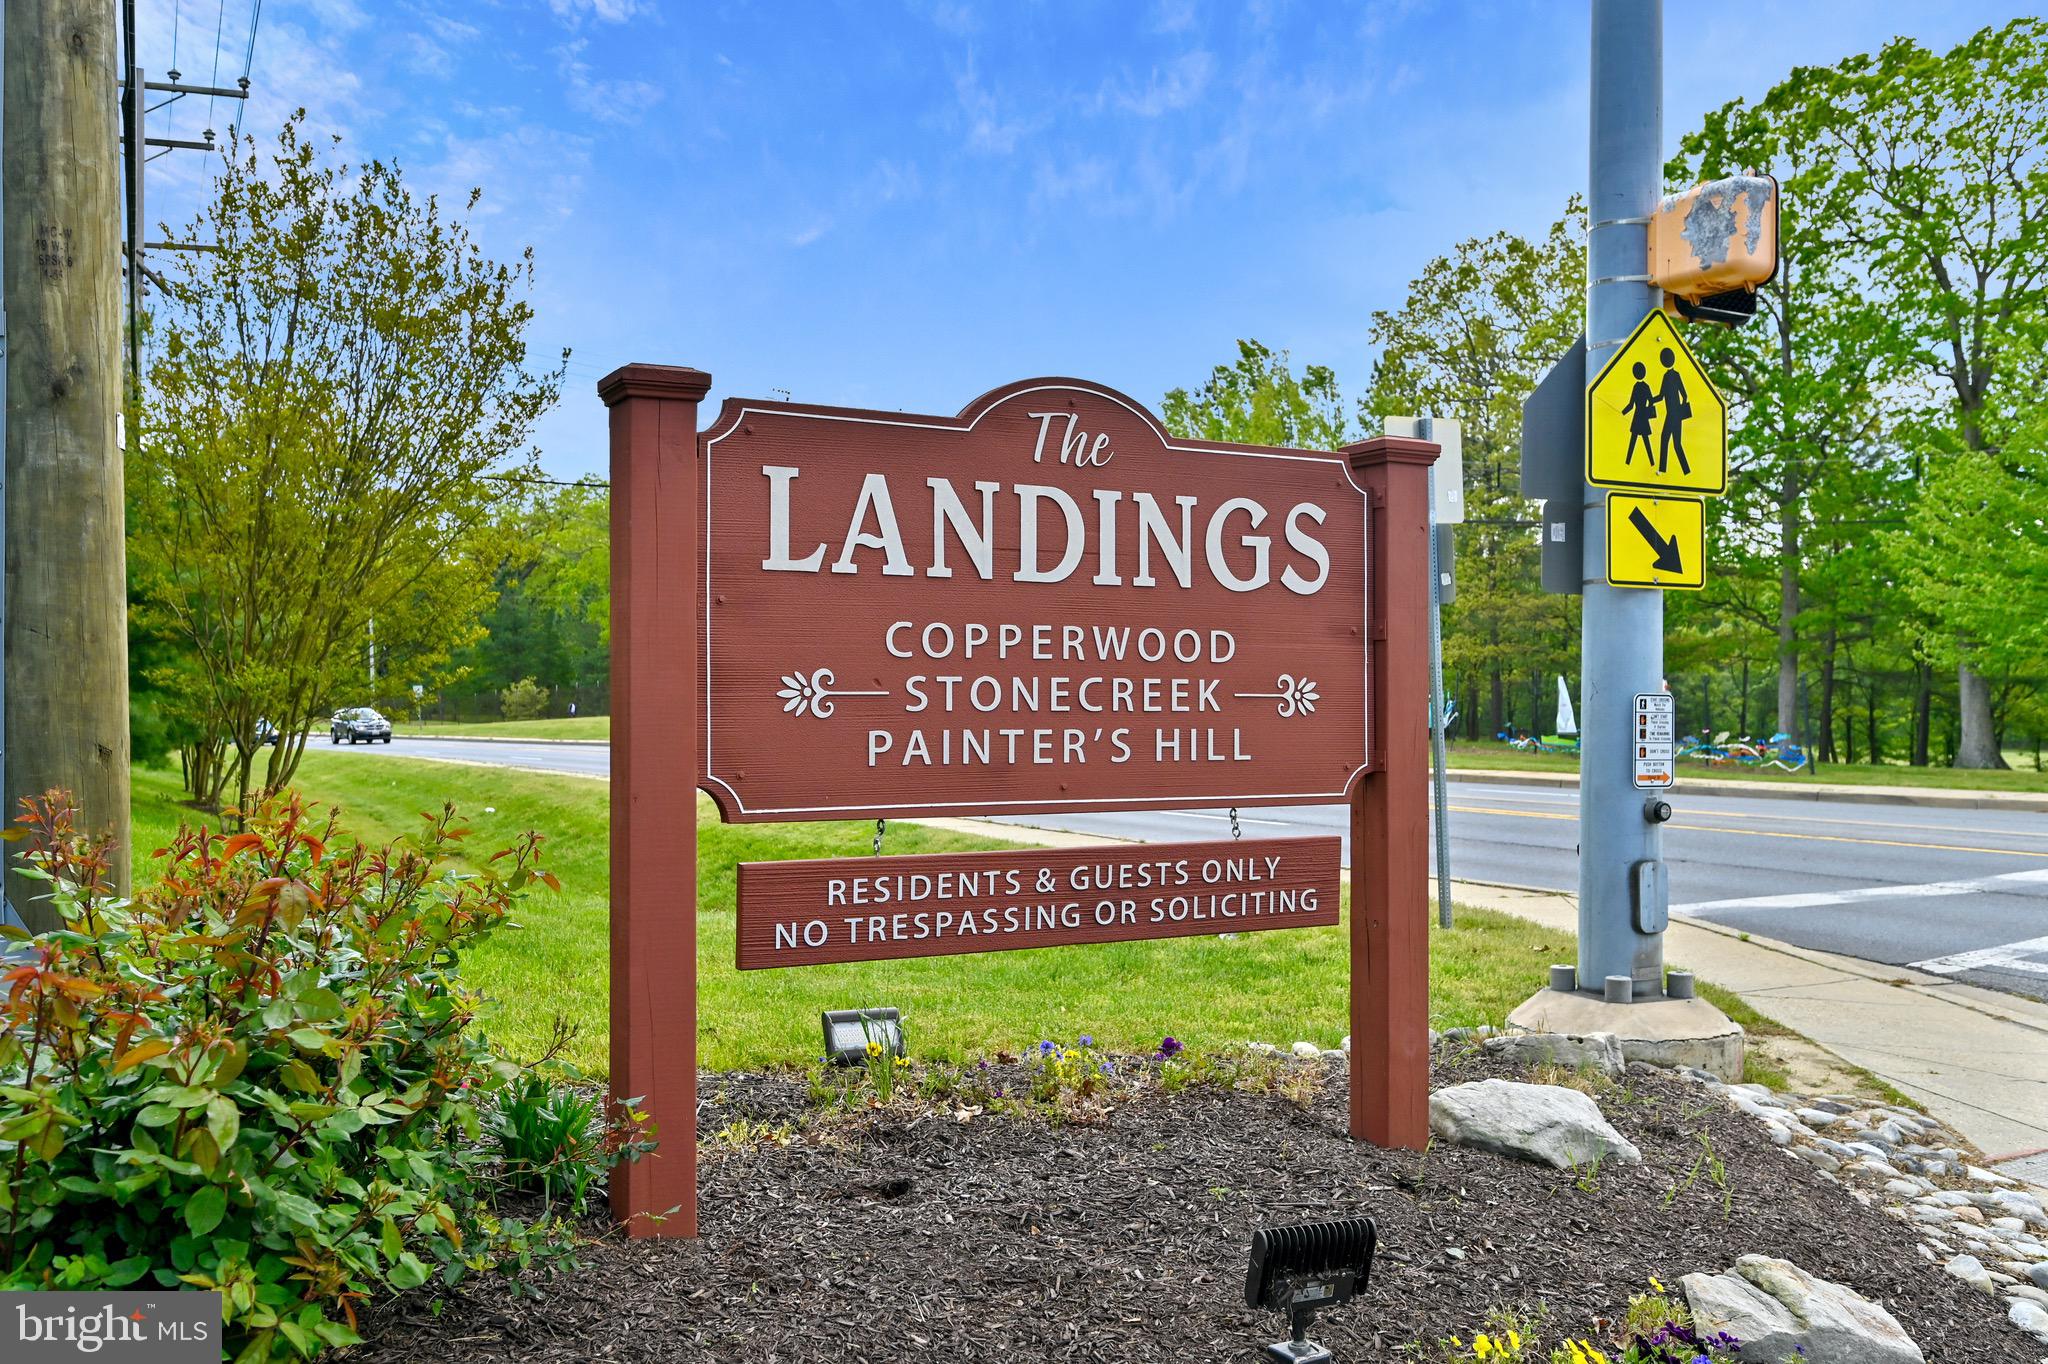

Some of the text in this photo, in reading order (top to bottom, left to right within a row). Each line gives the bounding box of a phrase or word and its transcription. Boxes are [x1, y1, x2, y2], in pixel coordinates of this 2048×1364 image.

[1027, 411, 1114, 468] The
[762, 464, 1331, 595] LANDINGS
[885, 620, 1237, 663] COPPERWOOD
[904, 675, 1222, 713] STONECREEK
[867, 727, 1253, 767] PAINTER'S HILL
[828, 856, 1281, 906] RESIDENTS & GUESTS ONLY
[775, 888, 1318, 950] NO TRESPASSING OR SOLICITING
